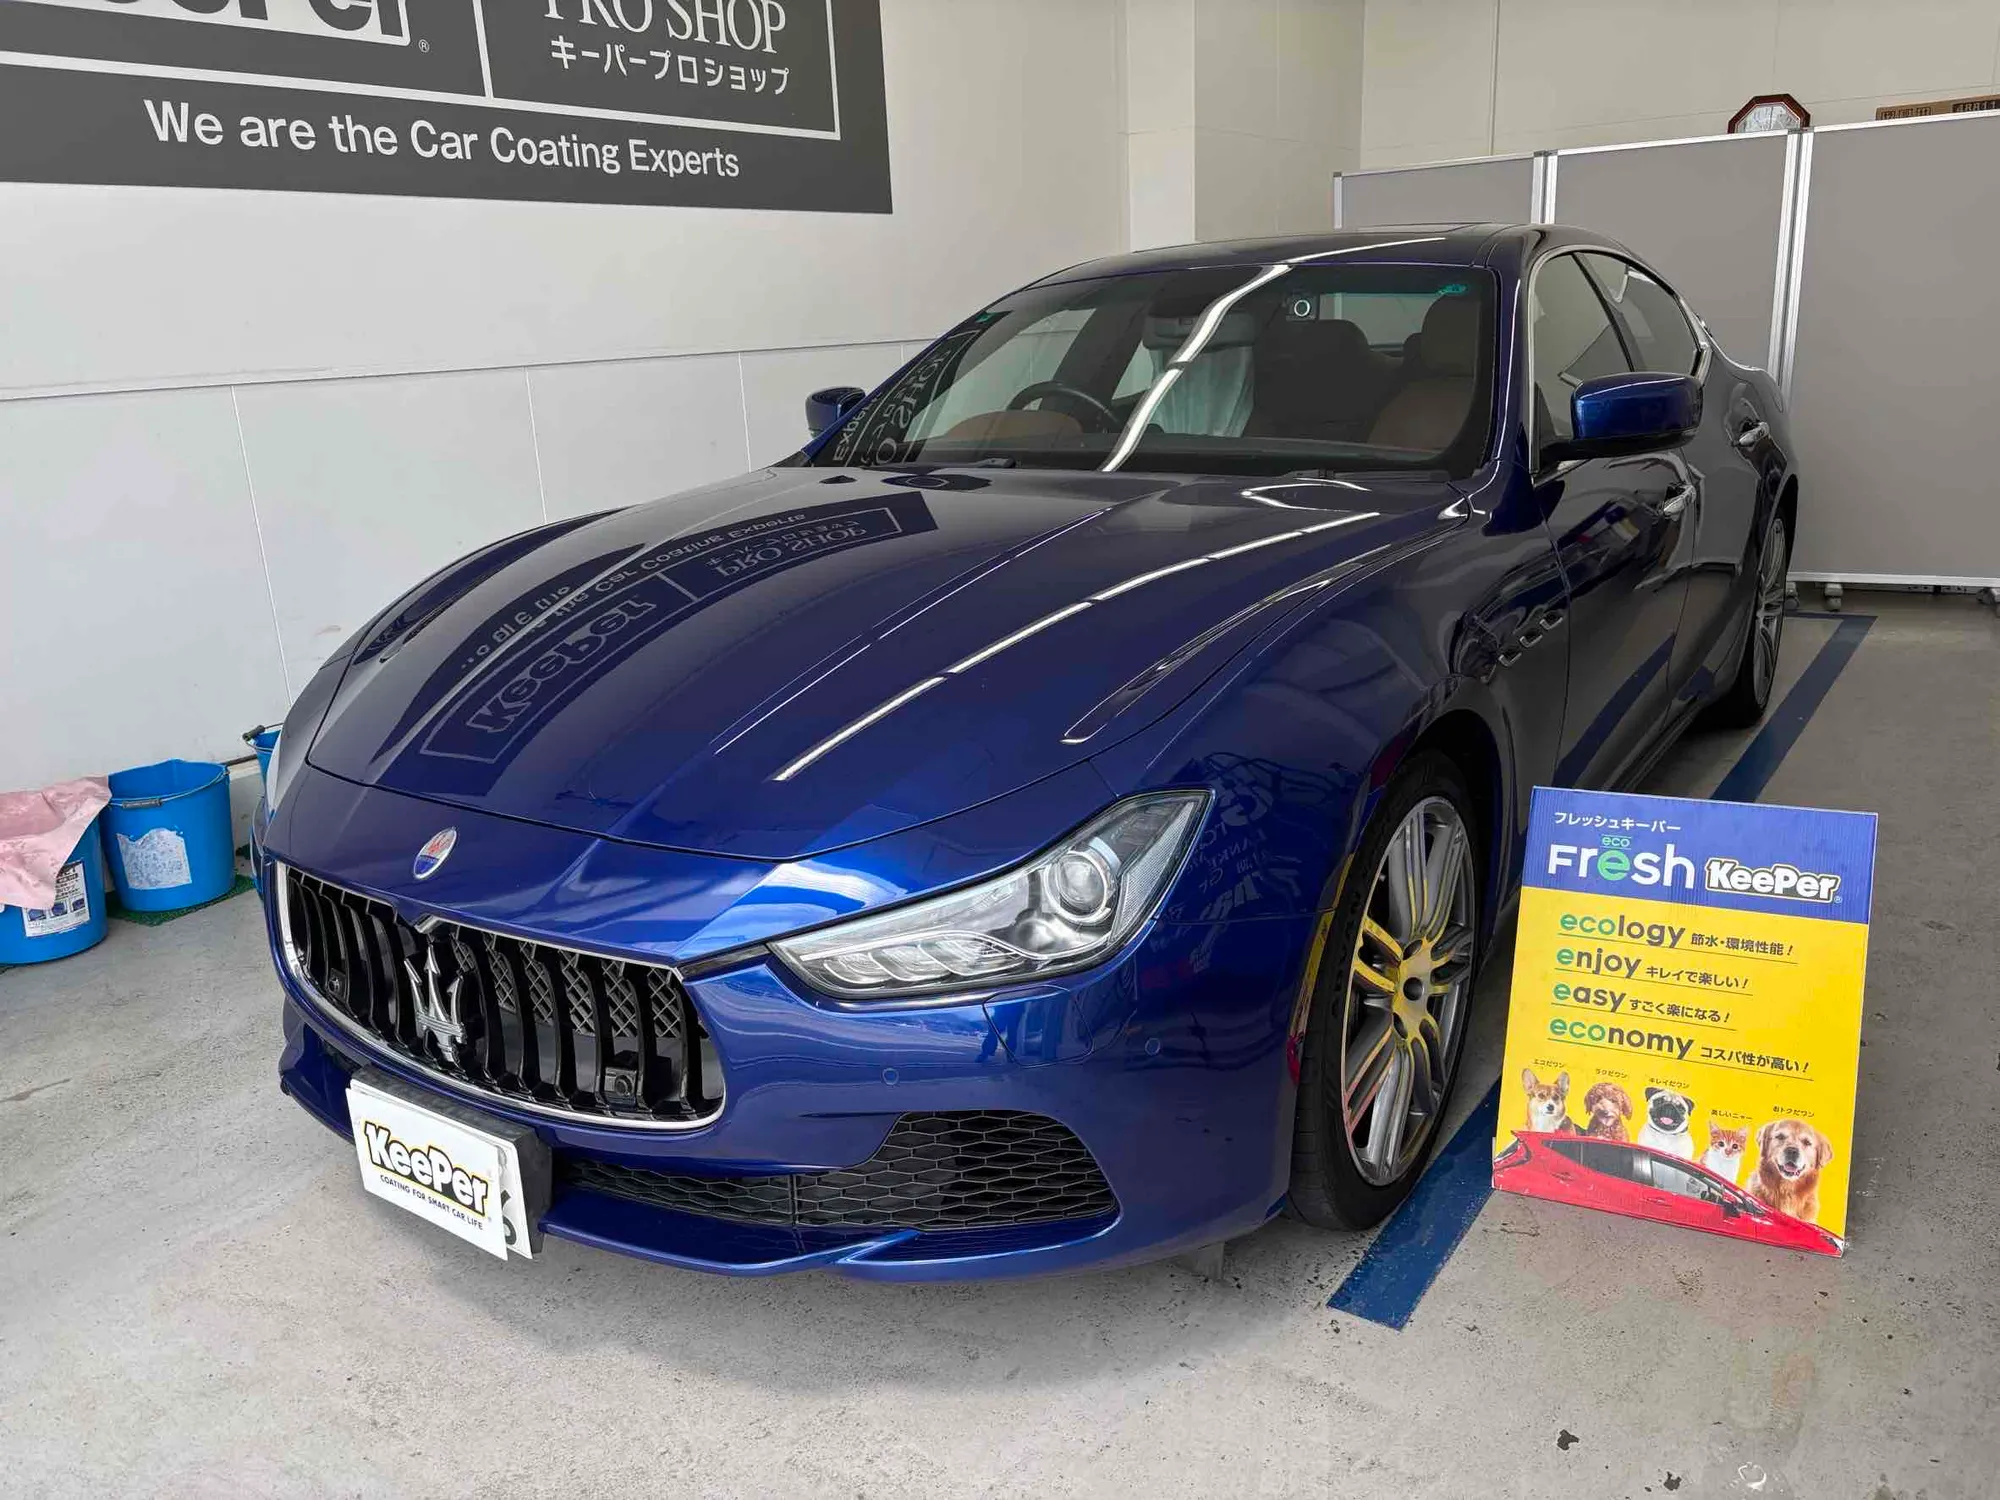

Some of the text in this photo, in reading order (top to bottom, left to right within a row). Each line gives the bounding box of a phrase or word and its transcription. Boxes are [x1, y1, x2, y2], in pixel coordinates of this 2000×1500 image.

[666, 0, 786, 53] SHOP
[550, 35, 790, 95] キーパープロショップ
[143, 99, 740, 177] We are the Car Coating Experts
[1554, 811, 1681, 833] フレッシュキーパー
[1601, 836, 1630, 848] eco
[1548, 843, 1840, 903] Fresh KeePer
[1560, 914, 1686, 948] ecology
[1556, 948, 1749, 989] enjoy キレイで楽しい！
[1553, 983, 1730, 1023] easy すごく楽になる！
[1549, 1018, 1810, 1073] economy コスパ性が高い！
[363, 1120, 489, 1217] KeePer
[379, 1174, 484, 1231] COATING FOR SMART CAR LIFE
